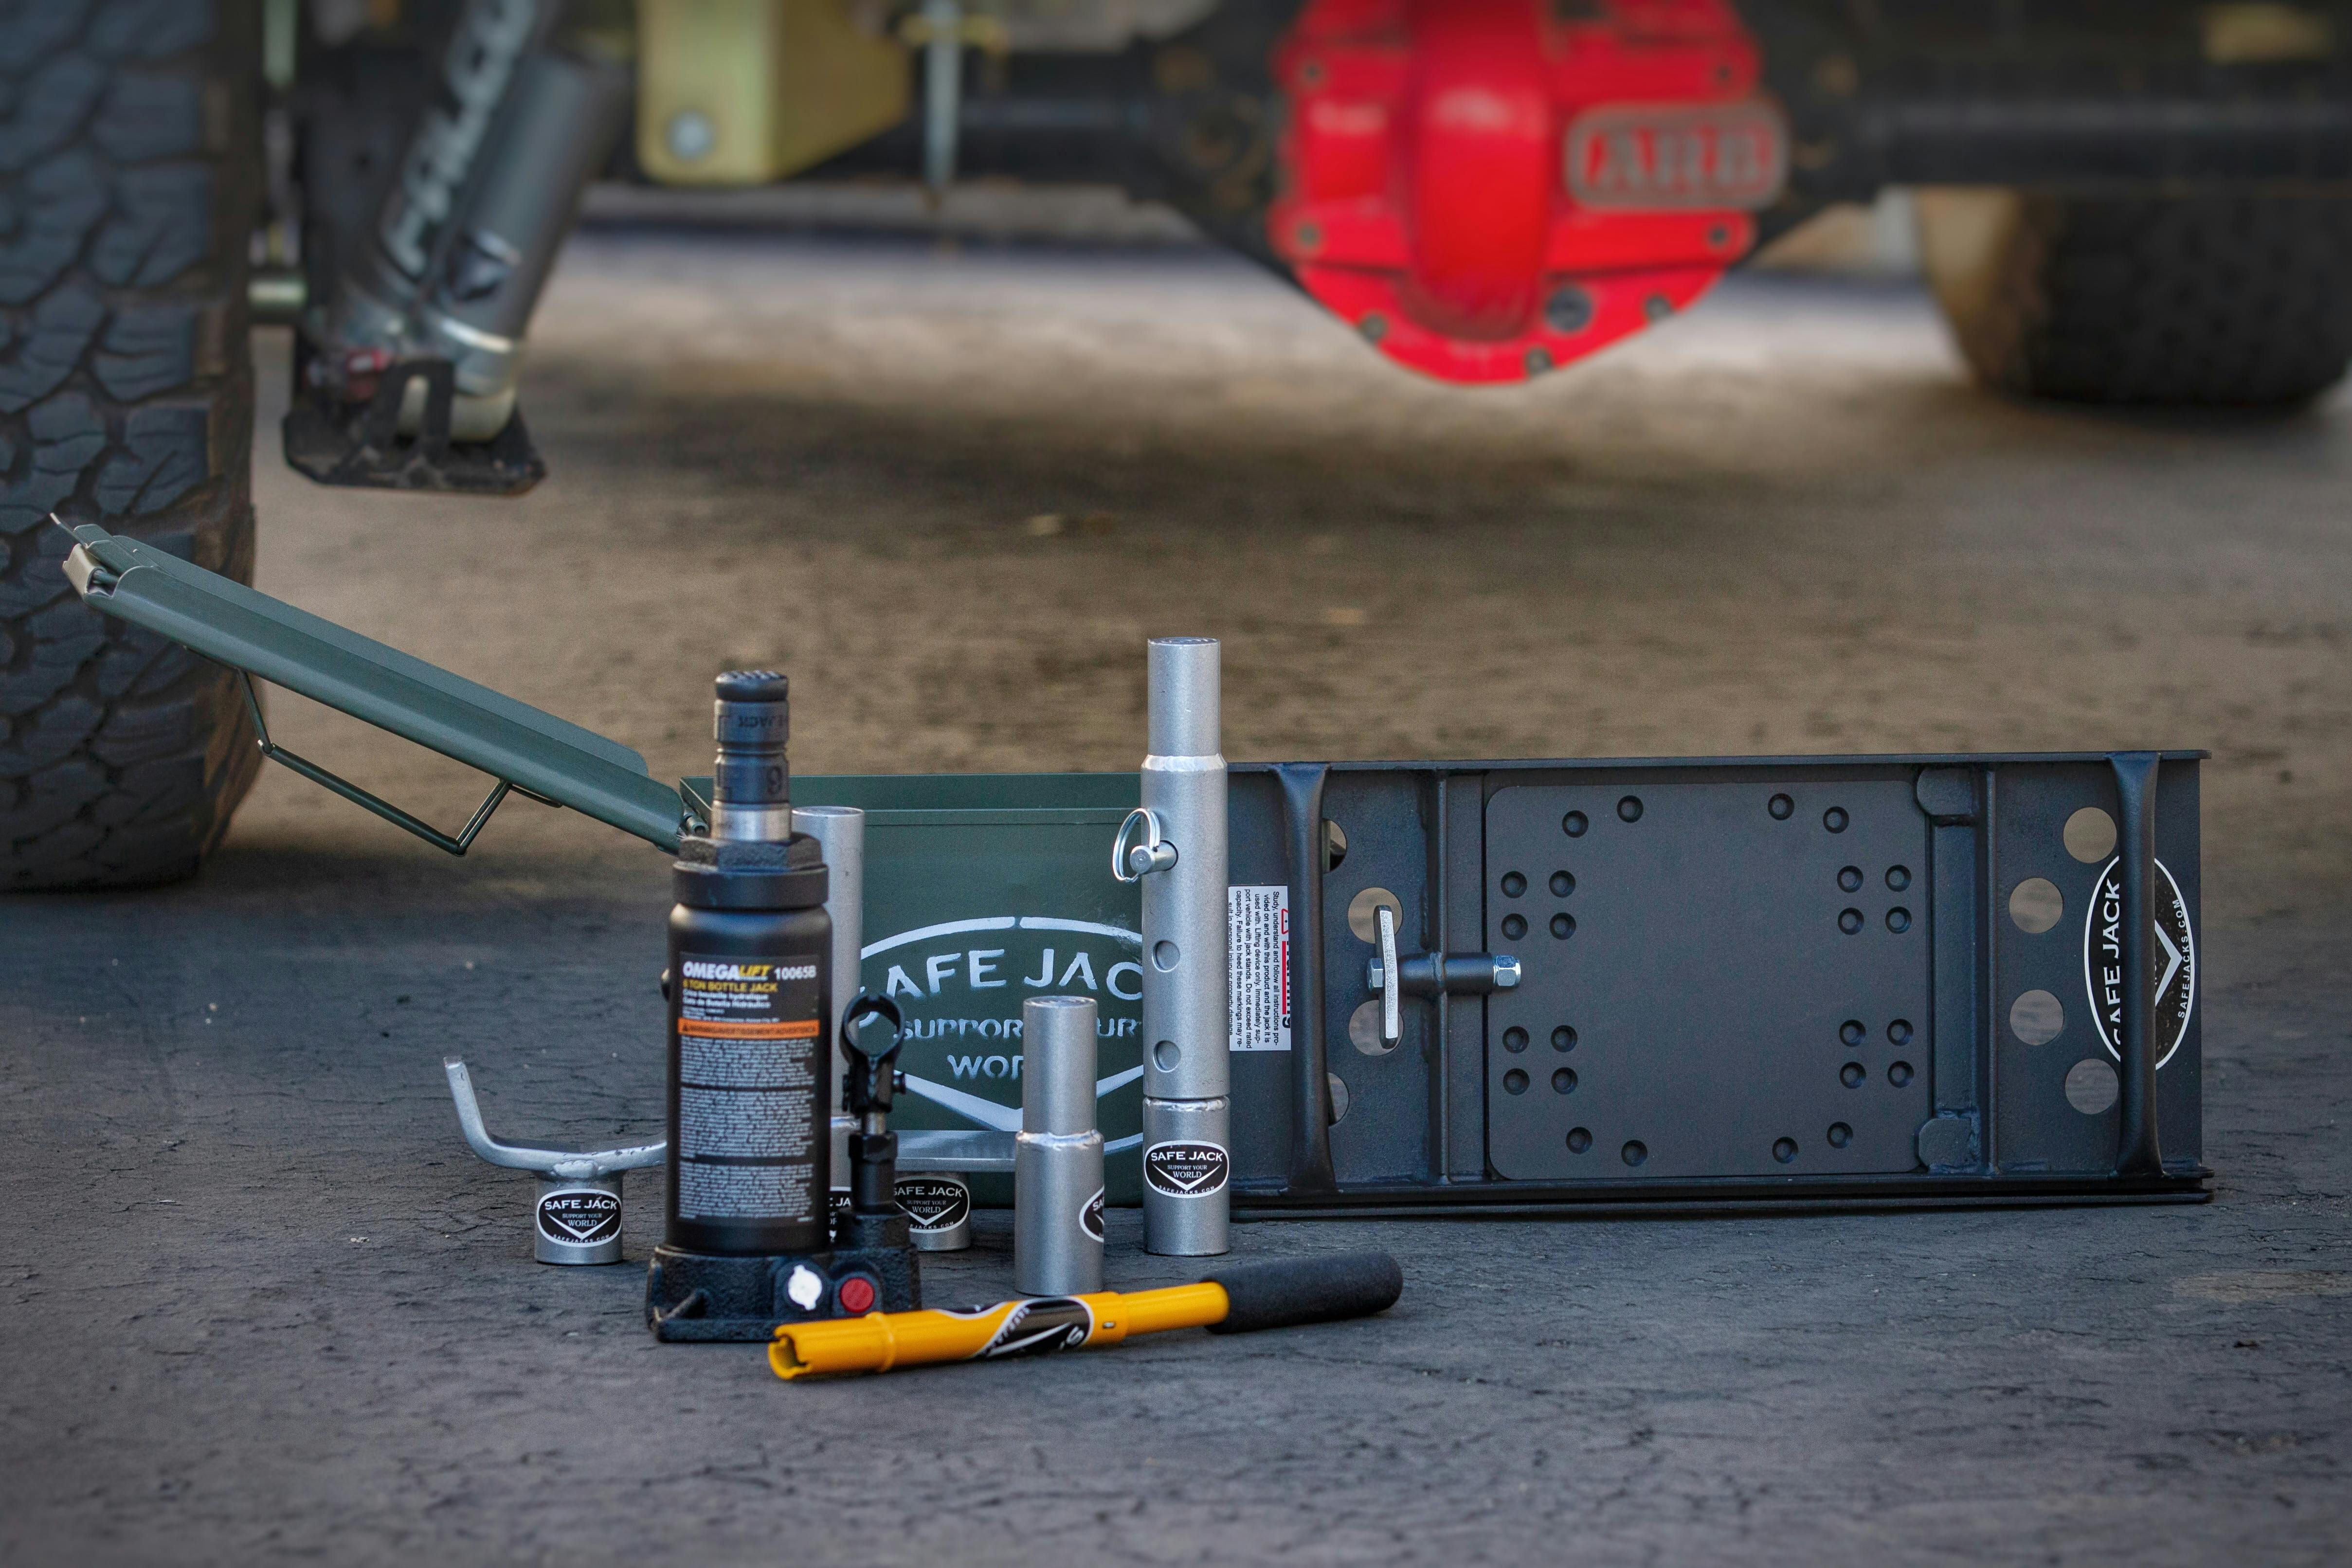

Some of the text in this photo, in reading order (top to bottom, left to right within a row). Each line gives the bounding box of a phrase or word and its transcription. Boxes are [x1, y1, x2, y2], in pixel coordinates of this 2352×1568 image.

[1271, 891, 1280, 911] Study,
[1264, 913, 1269, 921] on
[2103, 878, 2120, 959] JACK
[1253, 928, 1262, 947] Lifting
[2172, 899, 2191, 1018] SAFEJACKS.COM
[1253, 972, 1262, 987] only.
[1263, 965, 1271, 990] product
[707, 981, 747, 992] BOTTLE
[749, 983, 778, 993] JACK
[858, 949, 1142, 1028] AFE JAC
[1246, 983, 1252, 993] Do
[1263, 1016, 1271, 1030] jack
[894, 1019, 1023, 1040] SUPPOR
[1151, 1151, 1223, 1162] SAFE JACK
[928, 1187, 963, 1197] JACK
[1159, 1185, 1215, 1195] SAFEJACKS.COM
[544, 1199, 617, 1210] SAFE JACK
[835, 1197, 851, 1207] JA
[567, 1219, 597, 1227] WORLD
[909, 1221, 954, 1230] EJACKS.COM
